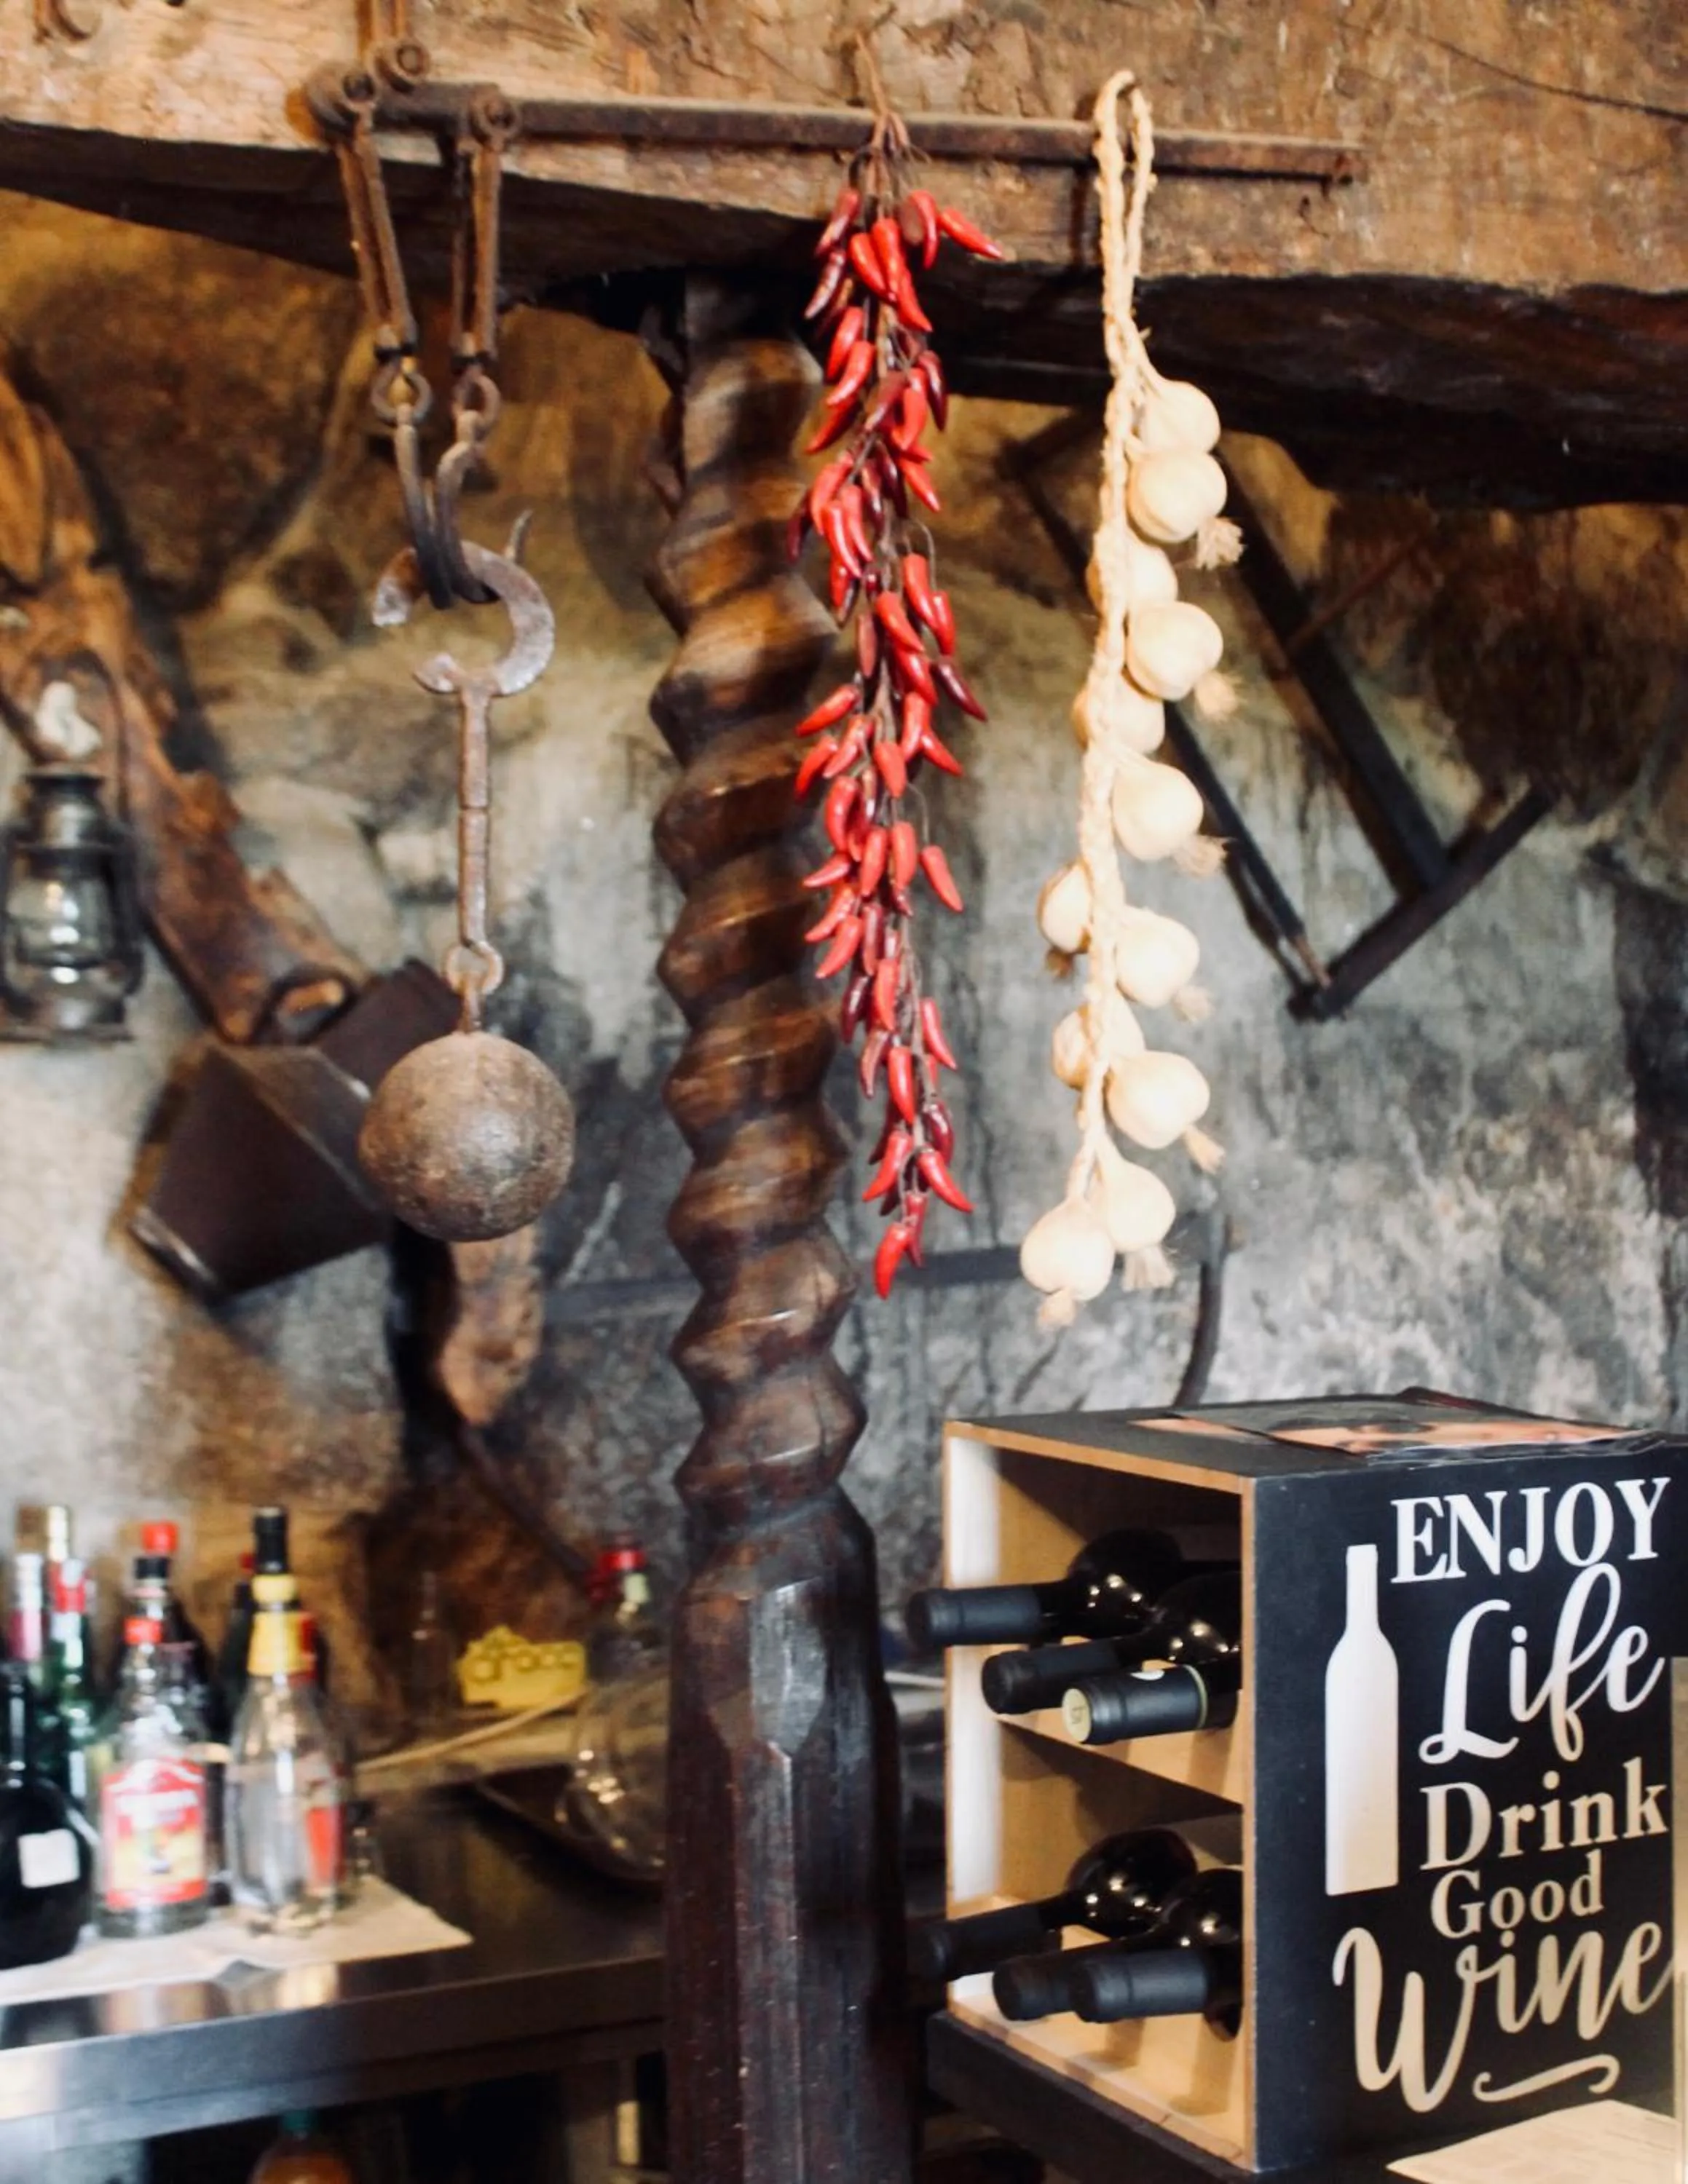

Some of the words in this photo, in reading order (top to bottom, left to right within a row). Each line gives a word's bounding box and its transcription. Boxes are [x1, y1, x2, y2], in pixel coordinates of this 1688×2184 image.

[1390, 1476, 1671, 1583] ENJOY
[1418, 1562, 1665, 1765] Life
[1419, 1757, 1668, 1870] Drink
[1430, 1848, 1604, 1939] Good
[1333, 1920, 1673, 2113] Wine
